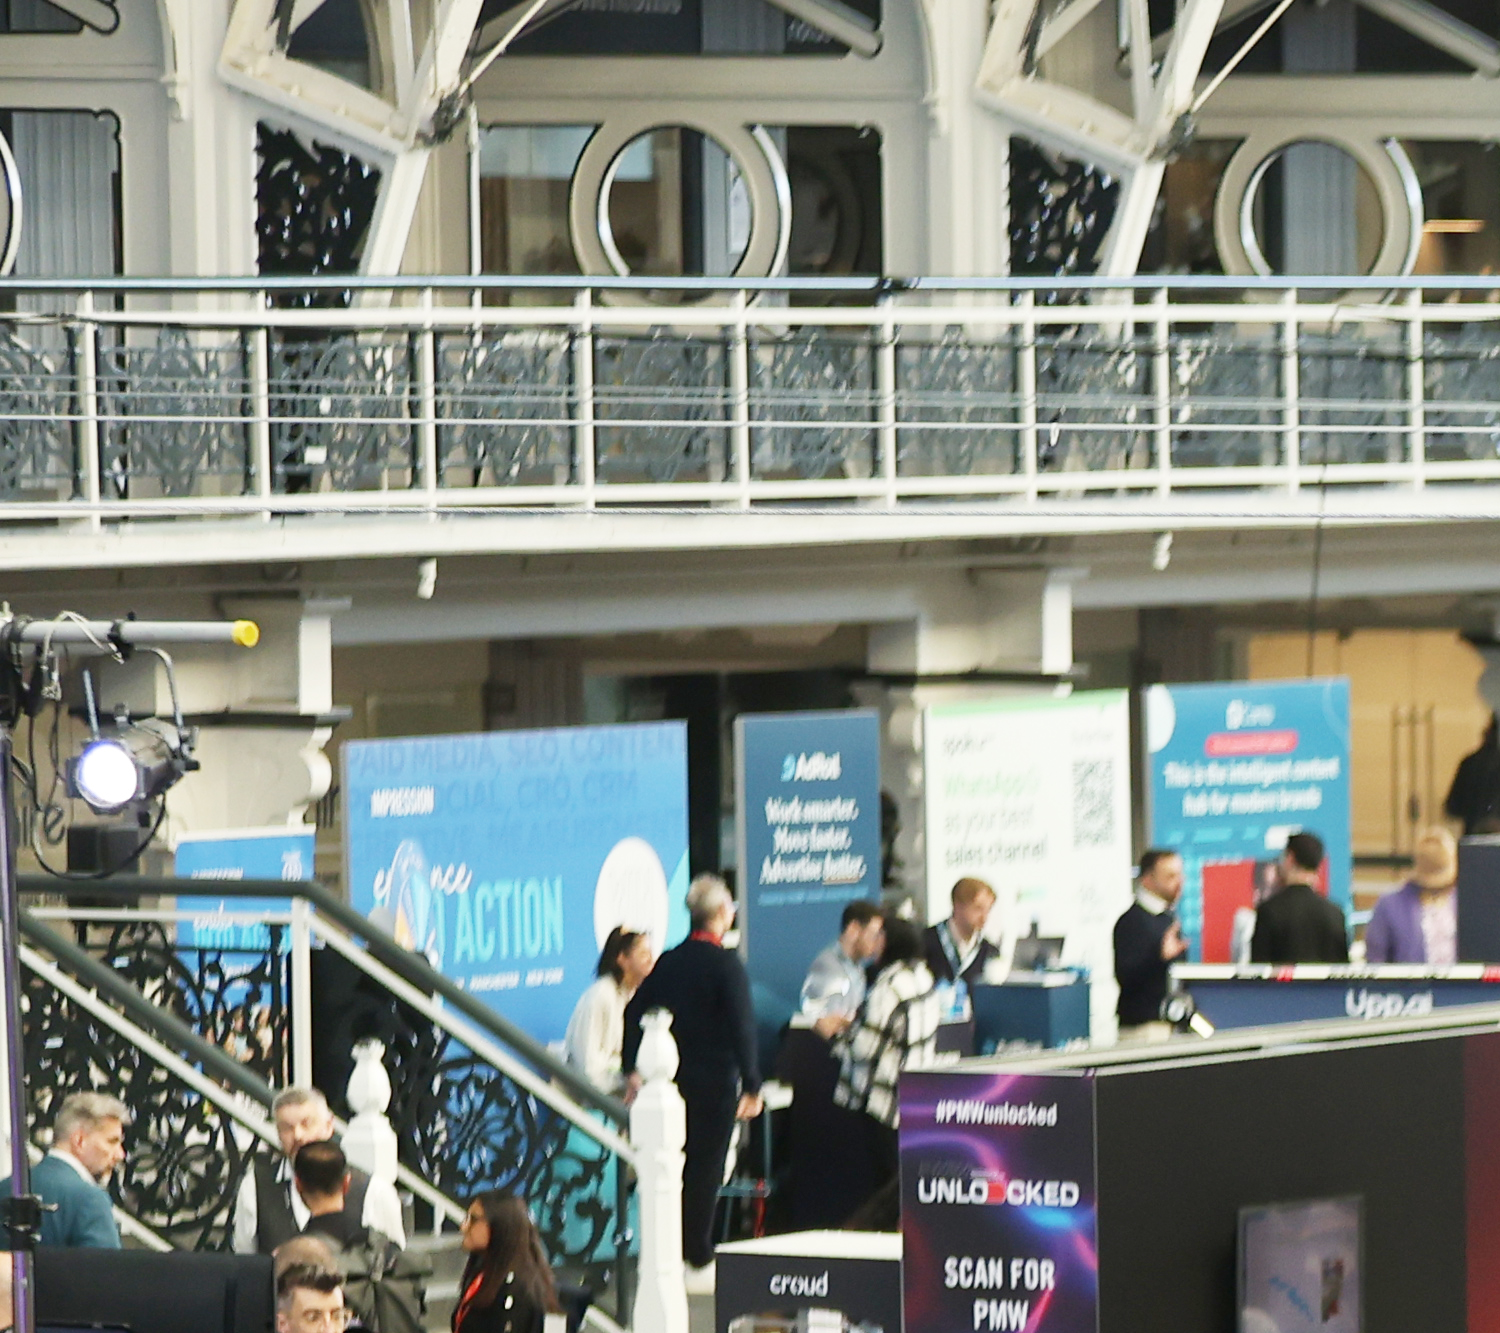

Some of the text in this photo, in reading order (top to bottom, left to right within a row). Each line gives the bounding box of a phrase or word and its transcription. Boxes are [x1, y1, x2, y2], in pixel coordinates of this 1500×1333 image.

[453, 875, 565, 964] ACTION
[935, 1099, 1059, 1128] #PMWunlocked
[917, 1177, 1080, 1208] UNLOCKED
[768, 1271, 830, 1298] croud
[944, 1255, 1056, 1292] SCAN FOR
[973, 1297, 1030, 1332] PMW
